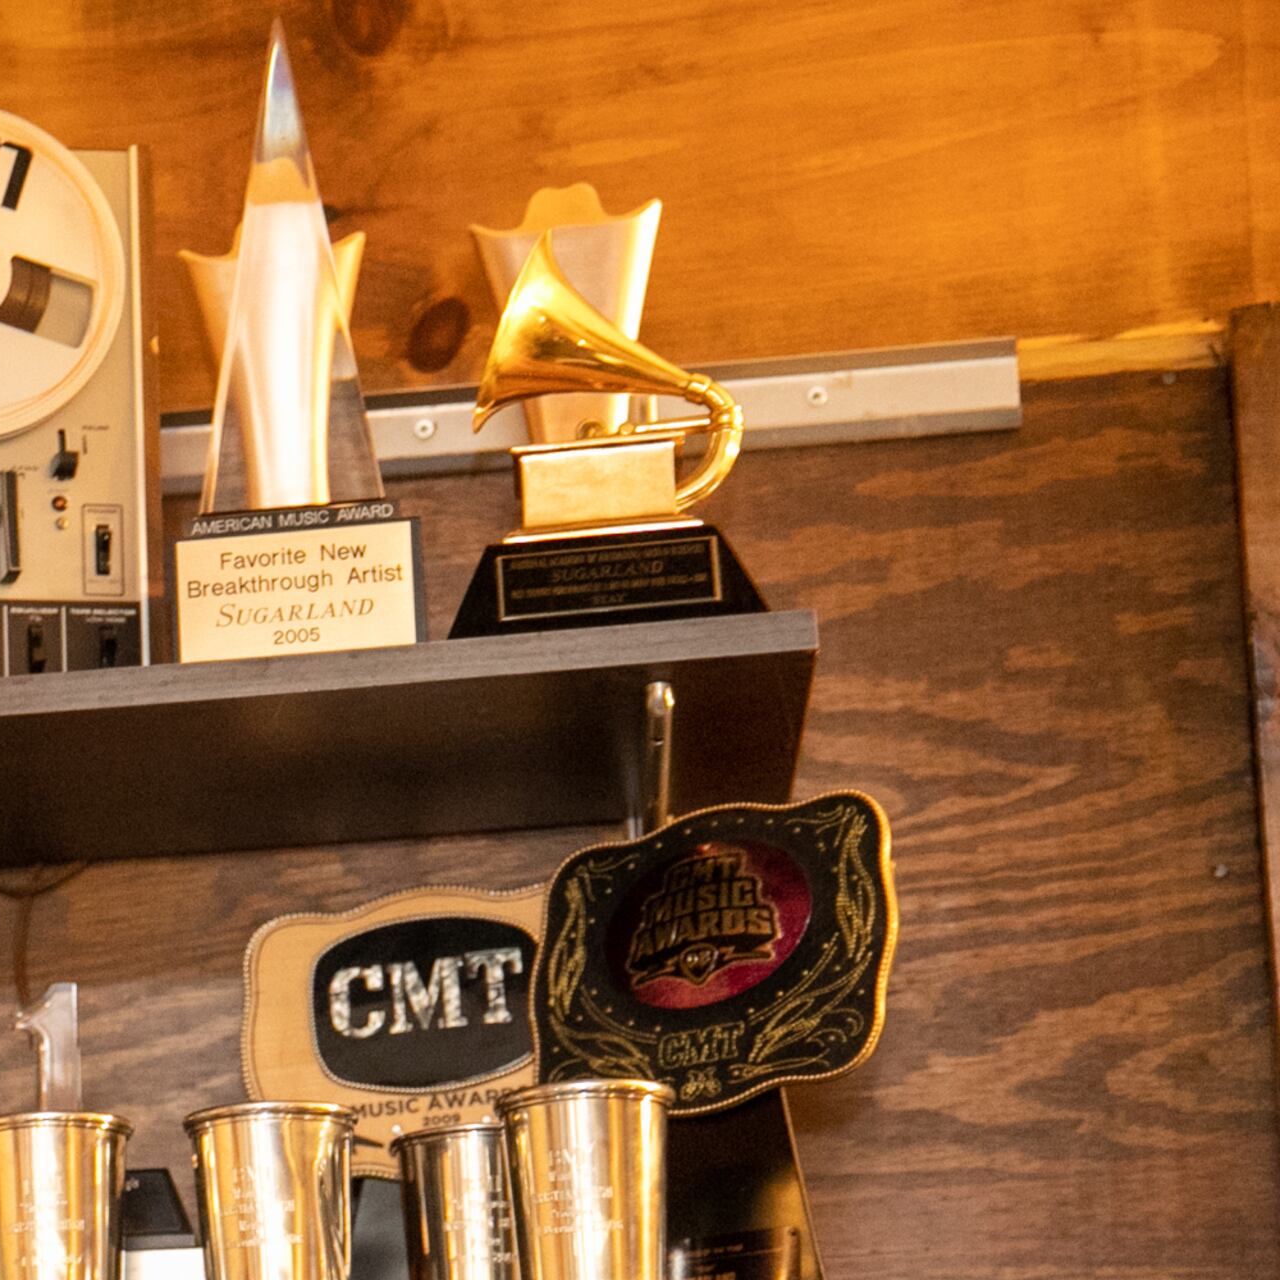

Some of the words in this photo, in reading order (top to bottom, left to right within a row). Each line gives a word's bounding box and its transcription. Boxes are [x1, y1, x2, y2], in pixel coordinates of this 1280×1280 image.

[192, 515, 273, 536] AMERICAN
[279, 509, 329, 527] MUSIC
[336, 503, 394, 521] AWARD
[220, 548, 307, 570] Favorite
[320, 543, 367, 561] New
[187, 570, 333, 600] Breakthrough
[347, 563, 403, 585] Artist
[273, 627, 321, 646] 2005
[671, 855, 738, 890] CMT
[651, 879, 757, 926] MUSIC
[636, 907, 774, 958] AWARDS
[328, 947, 524, 1039] CMT
[657, 1018, 746, 1070] CMT
[348, 1098, 420, 1120] MUSIC
[427, 1085, 524, 1113] AWAR
[422, 1113, 462, 1128] 2009
